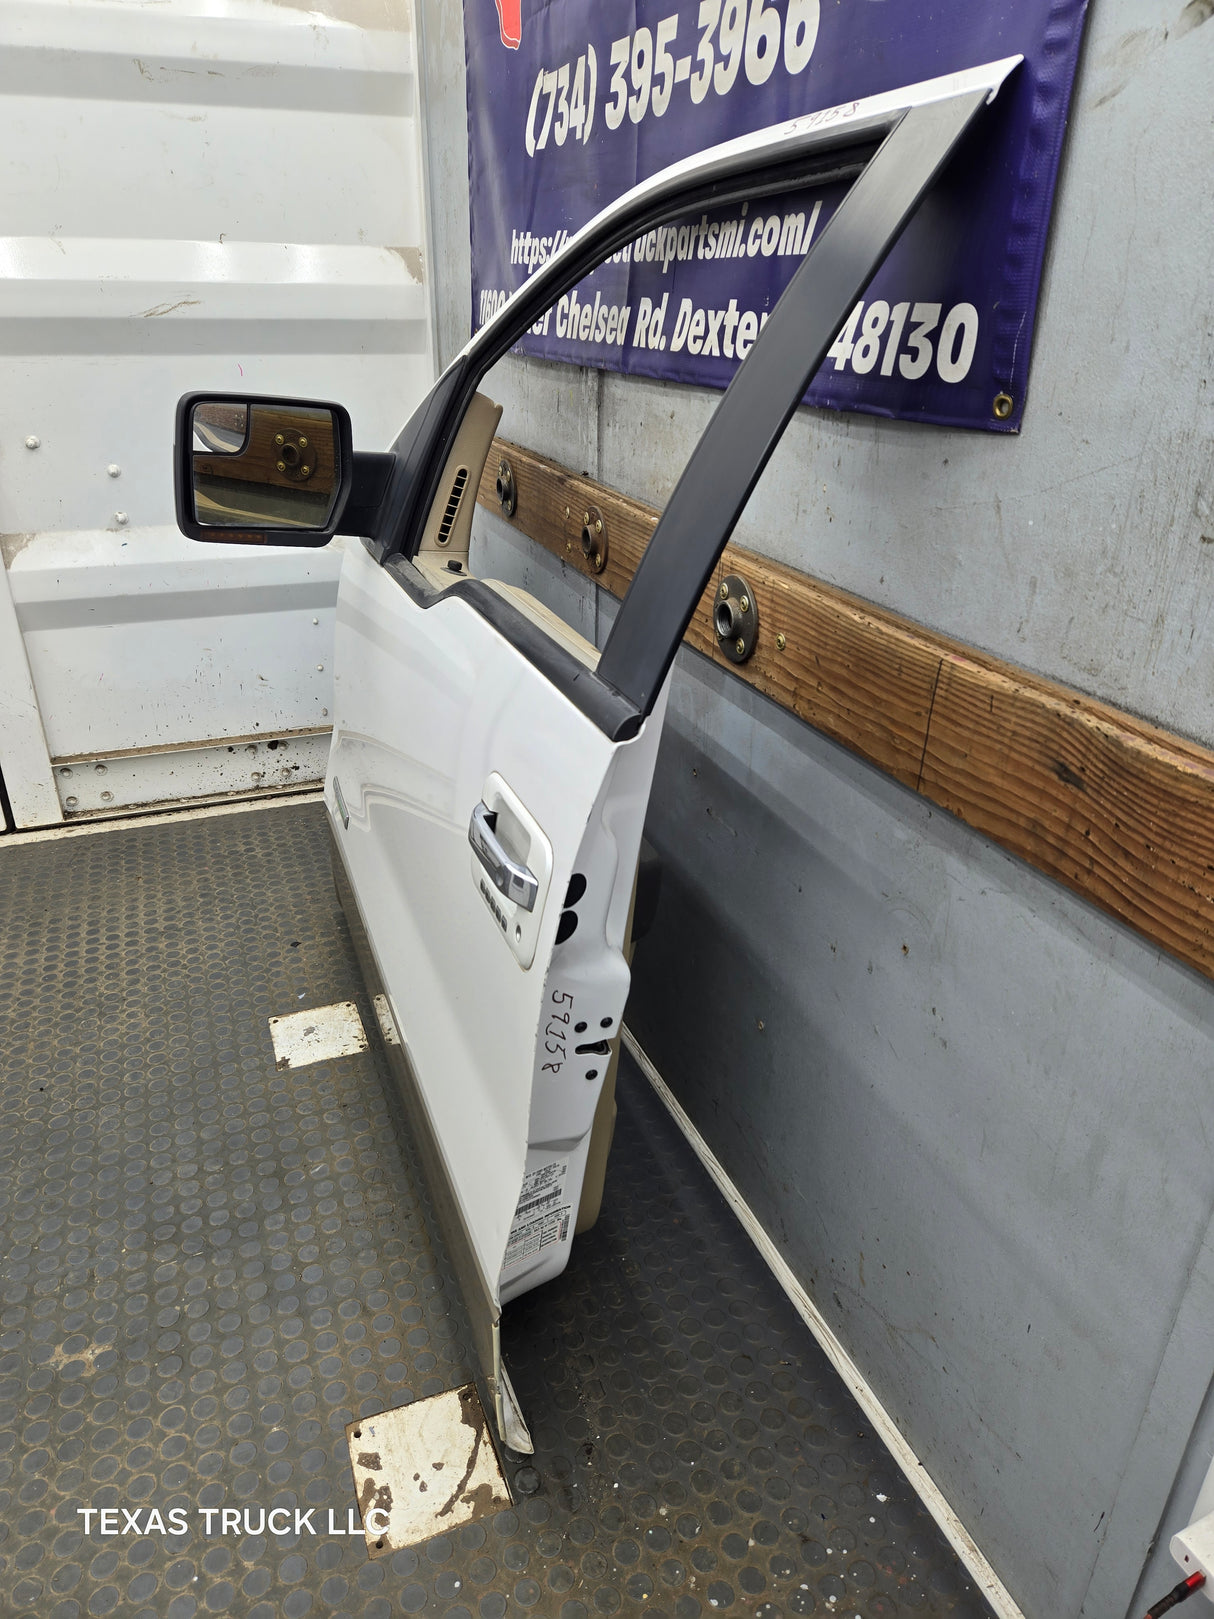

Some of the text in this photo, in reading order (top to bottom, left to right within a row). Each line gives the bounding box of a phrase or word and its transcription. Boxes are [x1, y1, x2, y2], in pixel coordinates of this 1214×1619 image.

[525, 0, 820, 158] (734) 395-3966
[556, 290, 632, 346] Chelsea
[633, 292, 669, 351] Rd.
[827, 300, 979, 383] 48130
